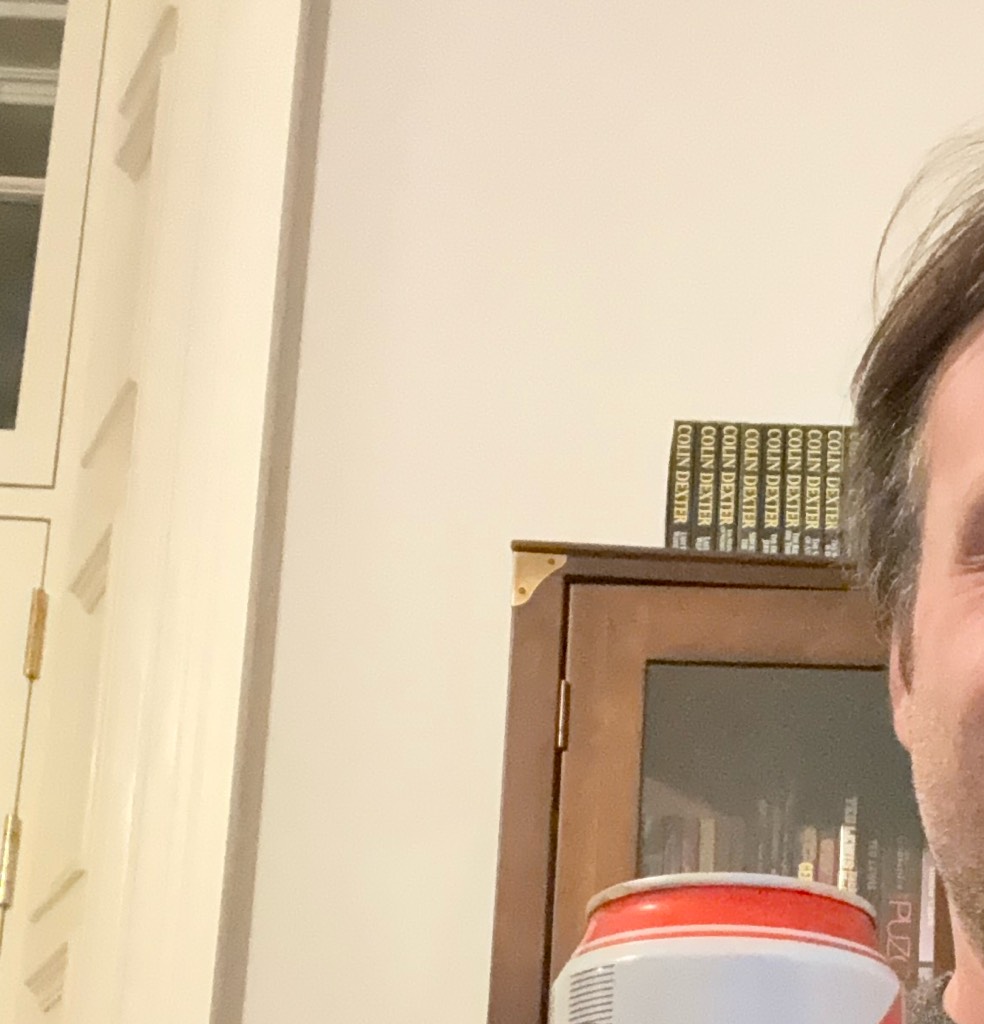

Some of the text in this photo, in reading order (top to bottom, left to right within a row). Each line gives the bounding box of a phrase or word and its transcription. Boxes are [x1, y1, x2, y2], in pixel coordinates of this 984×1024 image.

[676, 425, 692, 468] COLIN
[701, 426, 716, 469] COLIN
[722, 425, 738, 468] COLIN
[744, 428, 760, 472] COLIN
[766, 428, 782, 471] COLIN
[787, 428, 803, 471] COLIN
[807, 429, 823, 472] COLIN
[827, 430, 842, 473] COLIN
[673, 471, 690, 524] DEXTER
[697, 473, 714, 526] DEXTER
[719, 472, 736, 525] DEXTER
[741, 475, 758, 528] DEXTER
[764, 474, 781, 528] DEXTER
[785, 474, 802, 528] DEXTER
[804, 476, 821, 530] DEXTER
[825, 477, 841, 530] DEXTER
